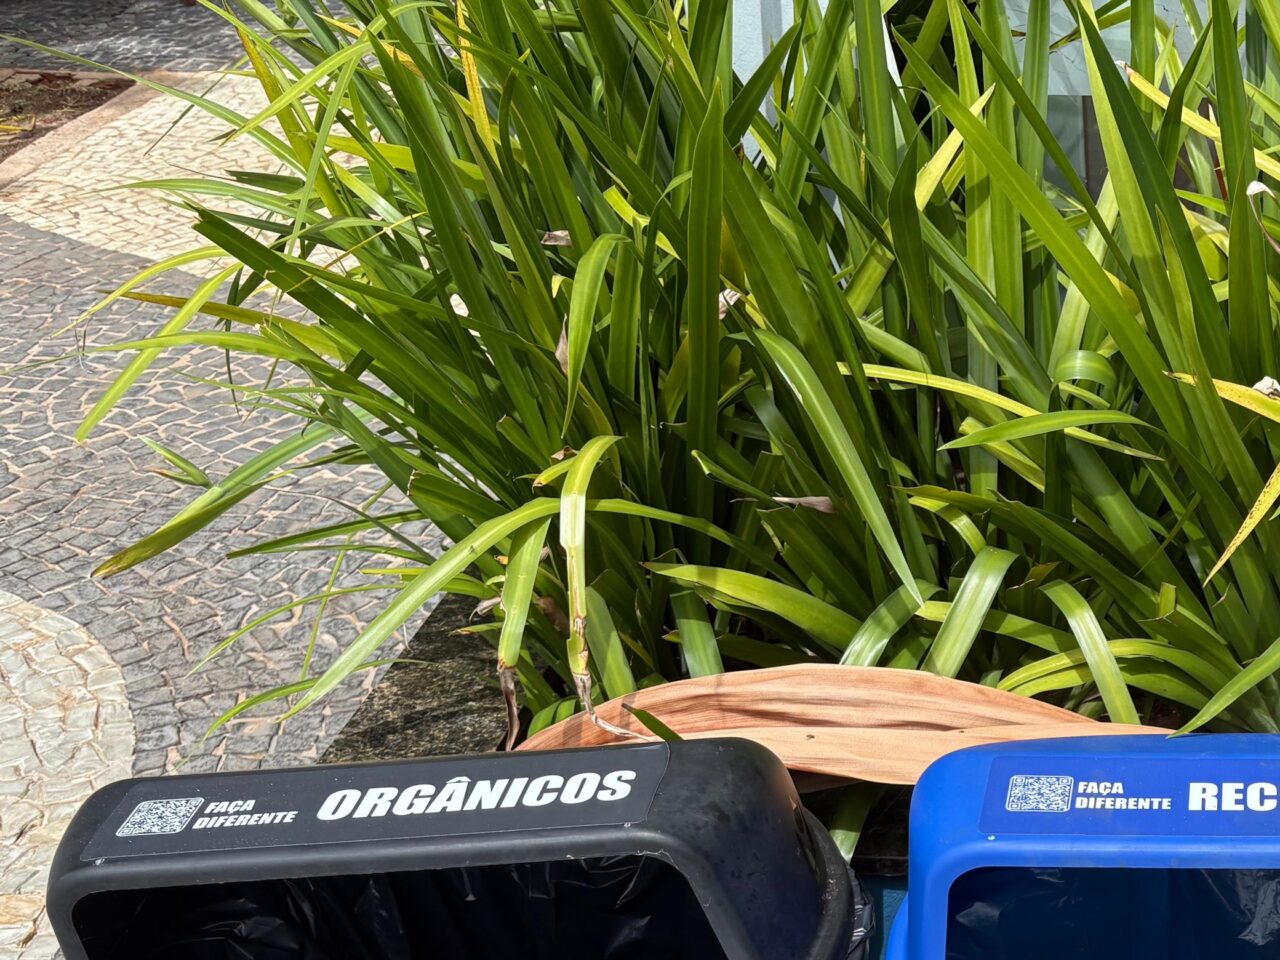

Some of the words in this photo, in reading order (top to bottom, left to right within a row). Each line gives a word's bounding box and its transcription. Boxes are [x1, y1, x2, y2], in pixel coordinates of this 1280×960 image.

[316, 770, 637, 821] ORGÂNICOS
[1078, 782, 1124, 796] FAÇA
[204, 800, 256, 815] FAÇA
[1076, 797, 1171, 810] DIFERENTE
[192, 811, 298, 829] DIFERENTE
